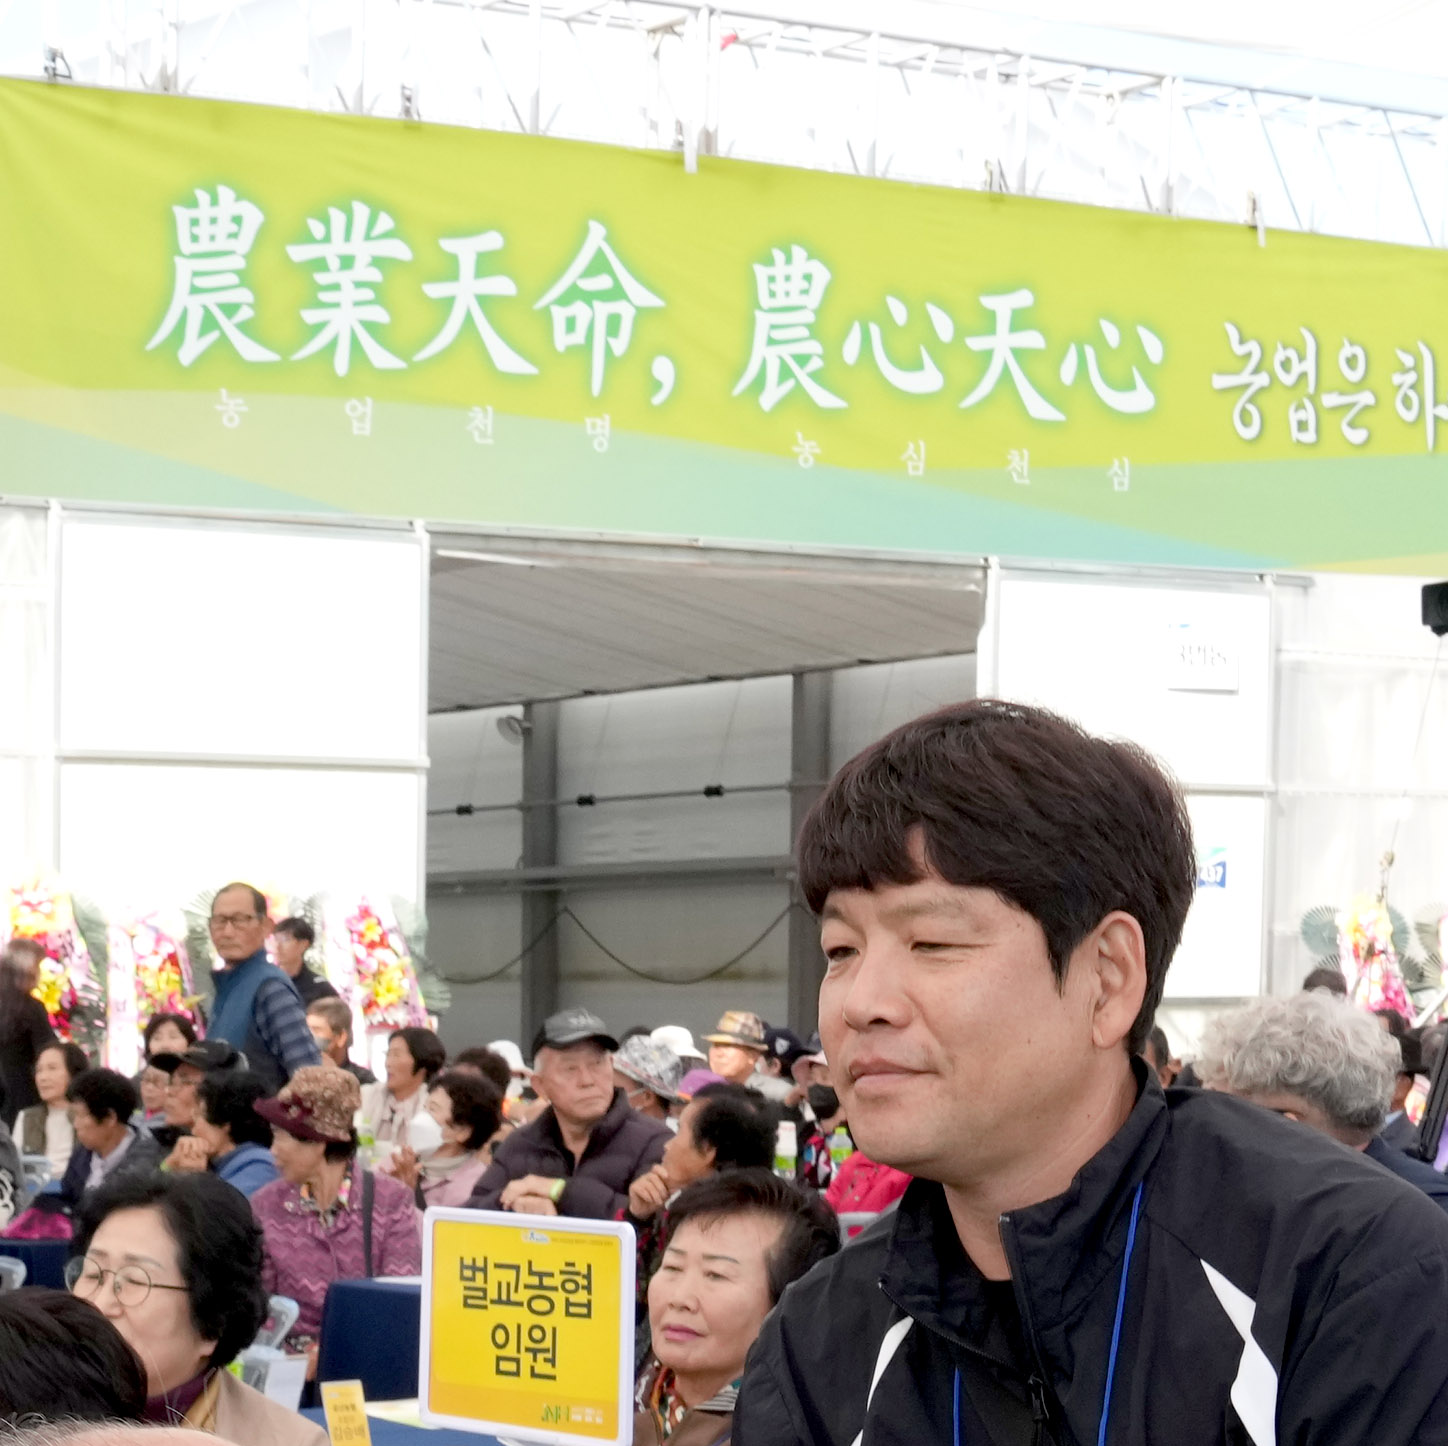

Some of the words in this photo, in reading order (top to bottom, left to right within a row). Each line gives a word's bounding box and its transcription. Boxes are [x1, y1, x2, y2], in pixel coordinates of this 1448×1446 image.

[145, 183, 677, 406] 農業天命,
[731, 244, 1163, 421] 農心天心
[1212, 322, 1379, 445] 농업은
[459, 1255, 593, 1320] 벌교농협
[490, 1322, 557, 1381] 임원
